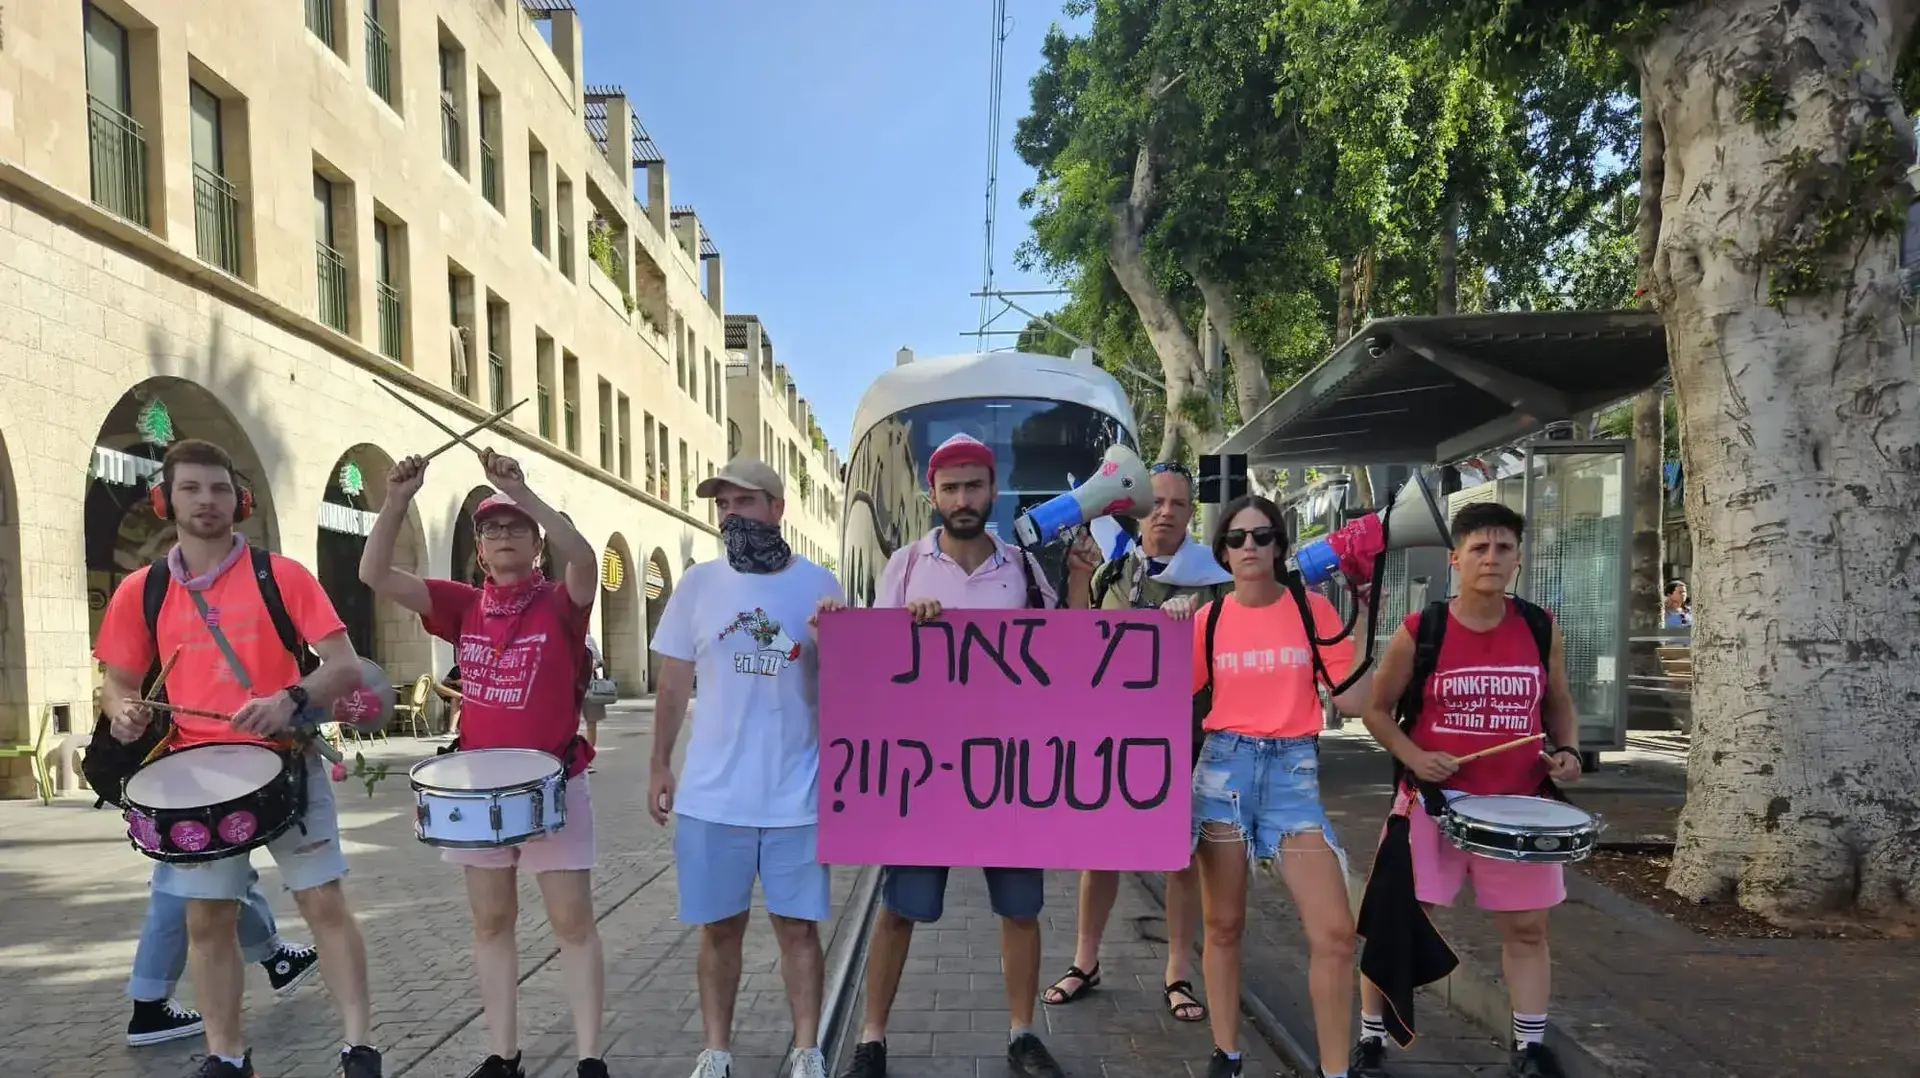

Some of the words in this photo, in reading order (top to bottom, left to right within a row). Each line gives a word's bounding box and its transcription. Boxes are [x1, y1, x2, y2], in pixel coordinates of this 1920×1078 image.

[891, 619, 1050, 686] זאת
[1091, 620, 1159, 688] מי
[484, 686, 522, 702] החזית
[1443, 676, 1531, 697] PINKFRONT
[1443, 697, 1487, 712] الوردية
[1490, 697, 1530, 712] الجبهة
[1443, 713, 1485, 728] הורודה
[1489, 715, 1528, 729] החזית
[829, 736, 1171, 817] סטטוס-קוו?
